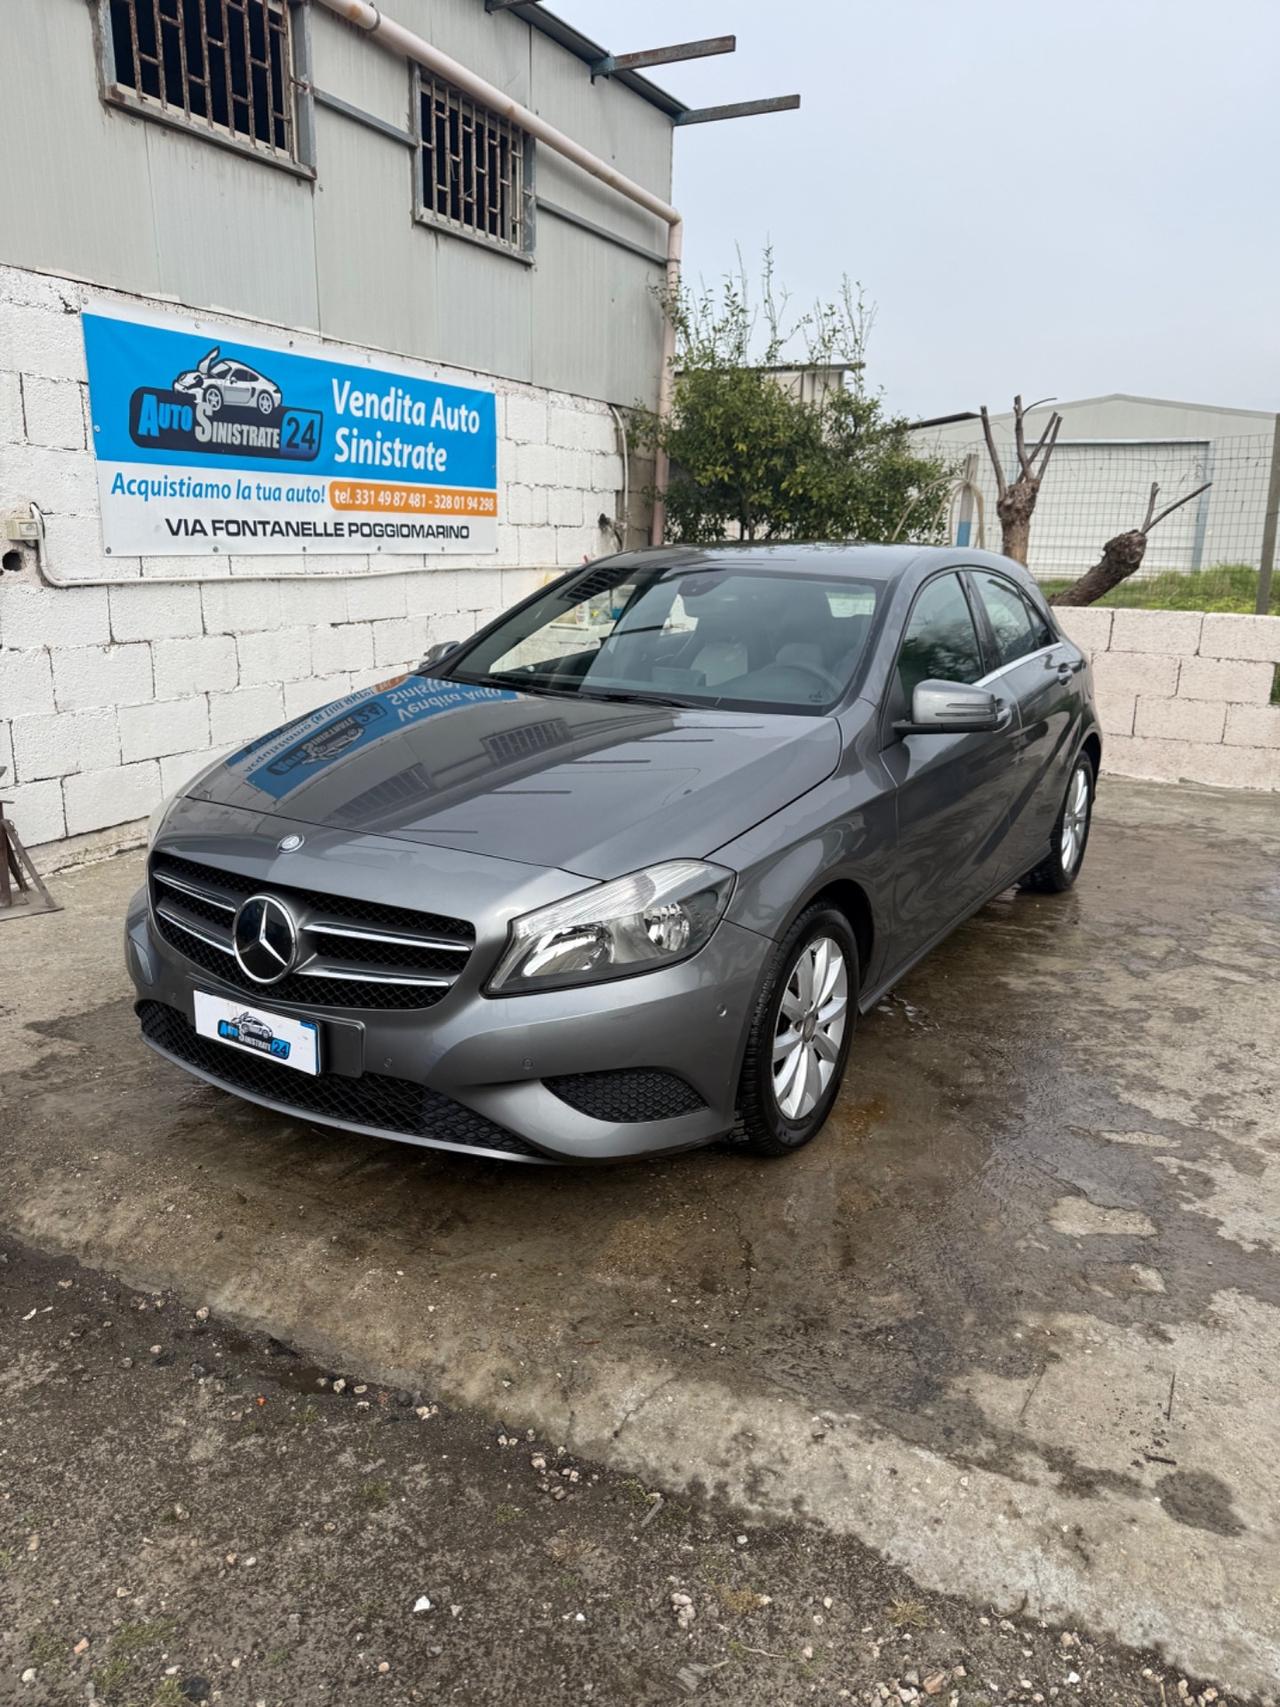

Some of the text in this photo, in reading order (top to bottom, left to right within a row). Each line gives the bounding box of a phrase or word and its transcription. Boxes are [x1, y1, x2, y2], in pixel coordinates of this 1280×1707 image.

[331, 378, 480, 434] Vendita Auto
[286, 416, 316, 450] 24
[334, 426, 448, 472] Sinistrate
[111, 472, 325, 503] Acquistiamo la tua auto!
[334, 488, 353, 504] tel.
[355, 489, 375, 506] 331
[378, 490, 391, 506] 49
[393, 491, 407, 507] 87
[408, 493, 426, 508] 481
[434, 494, 452, 509] 328
[453, 495, 465, 510] 01
[466, 496, 478, 511] 94
[165, 518, 470, 540] VIA FONTANELLE POGGIOMARINO
[273, 1041, 288, 1054] 24
